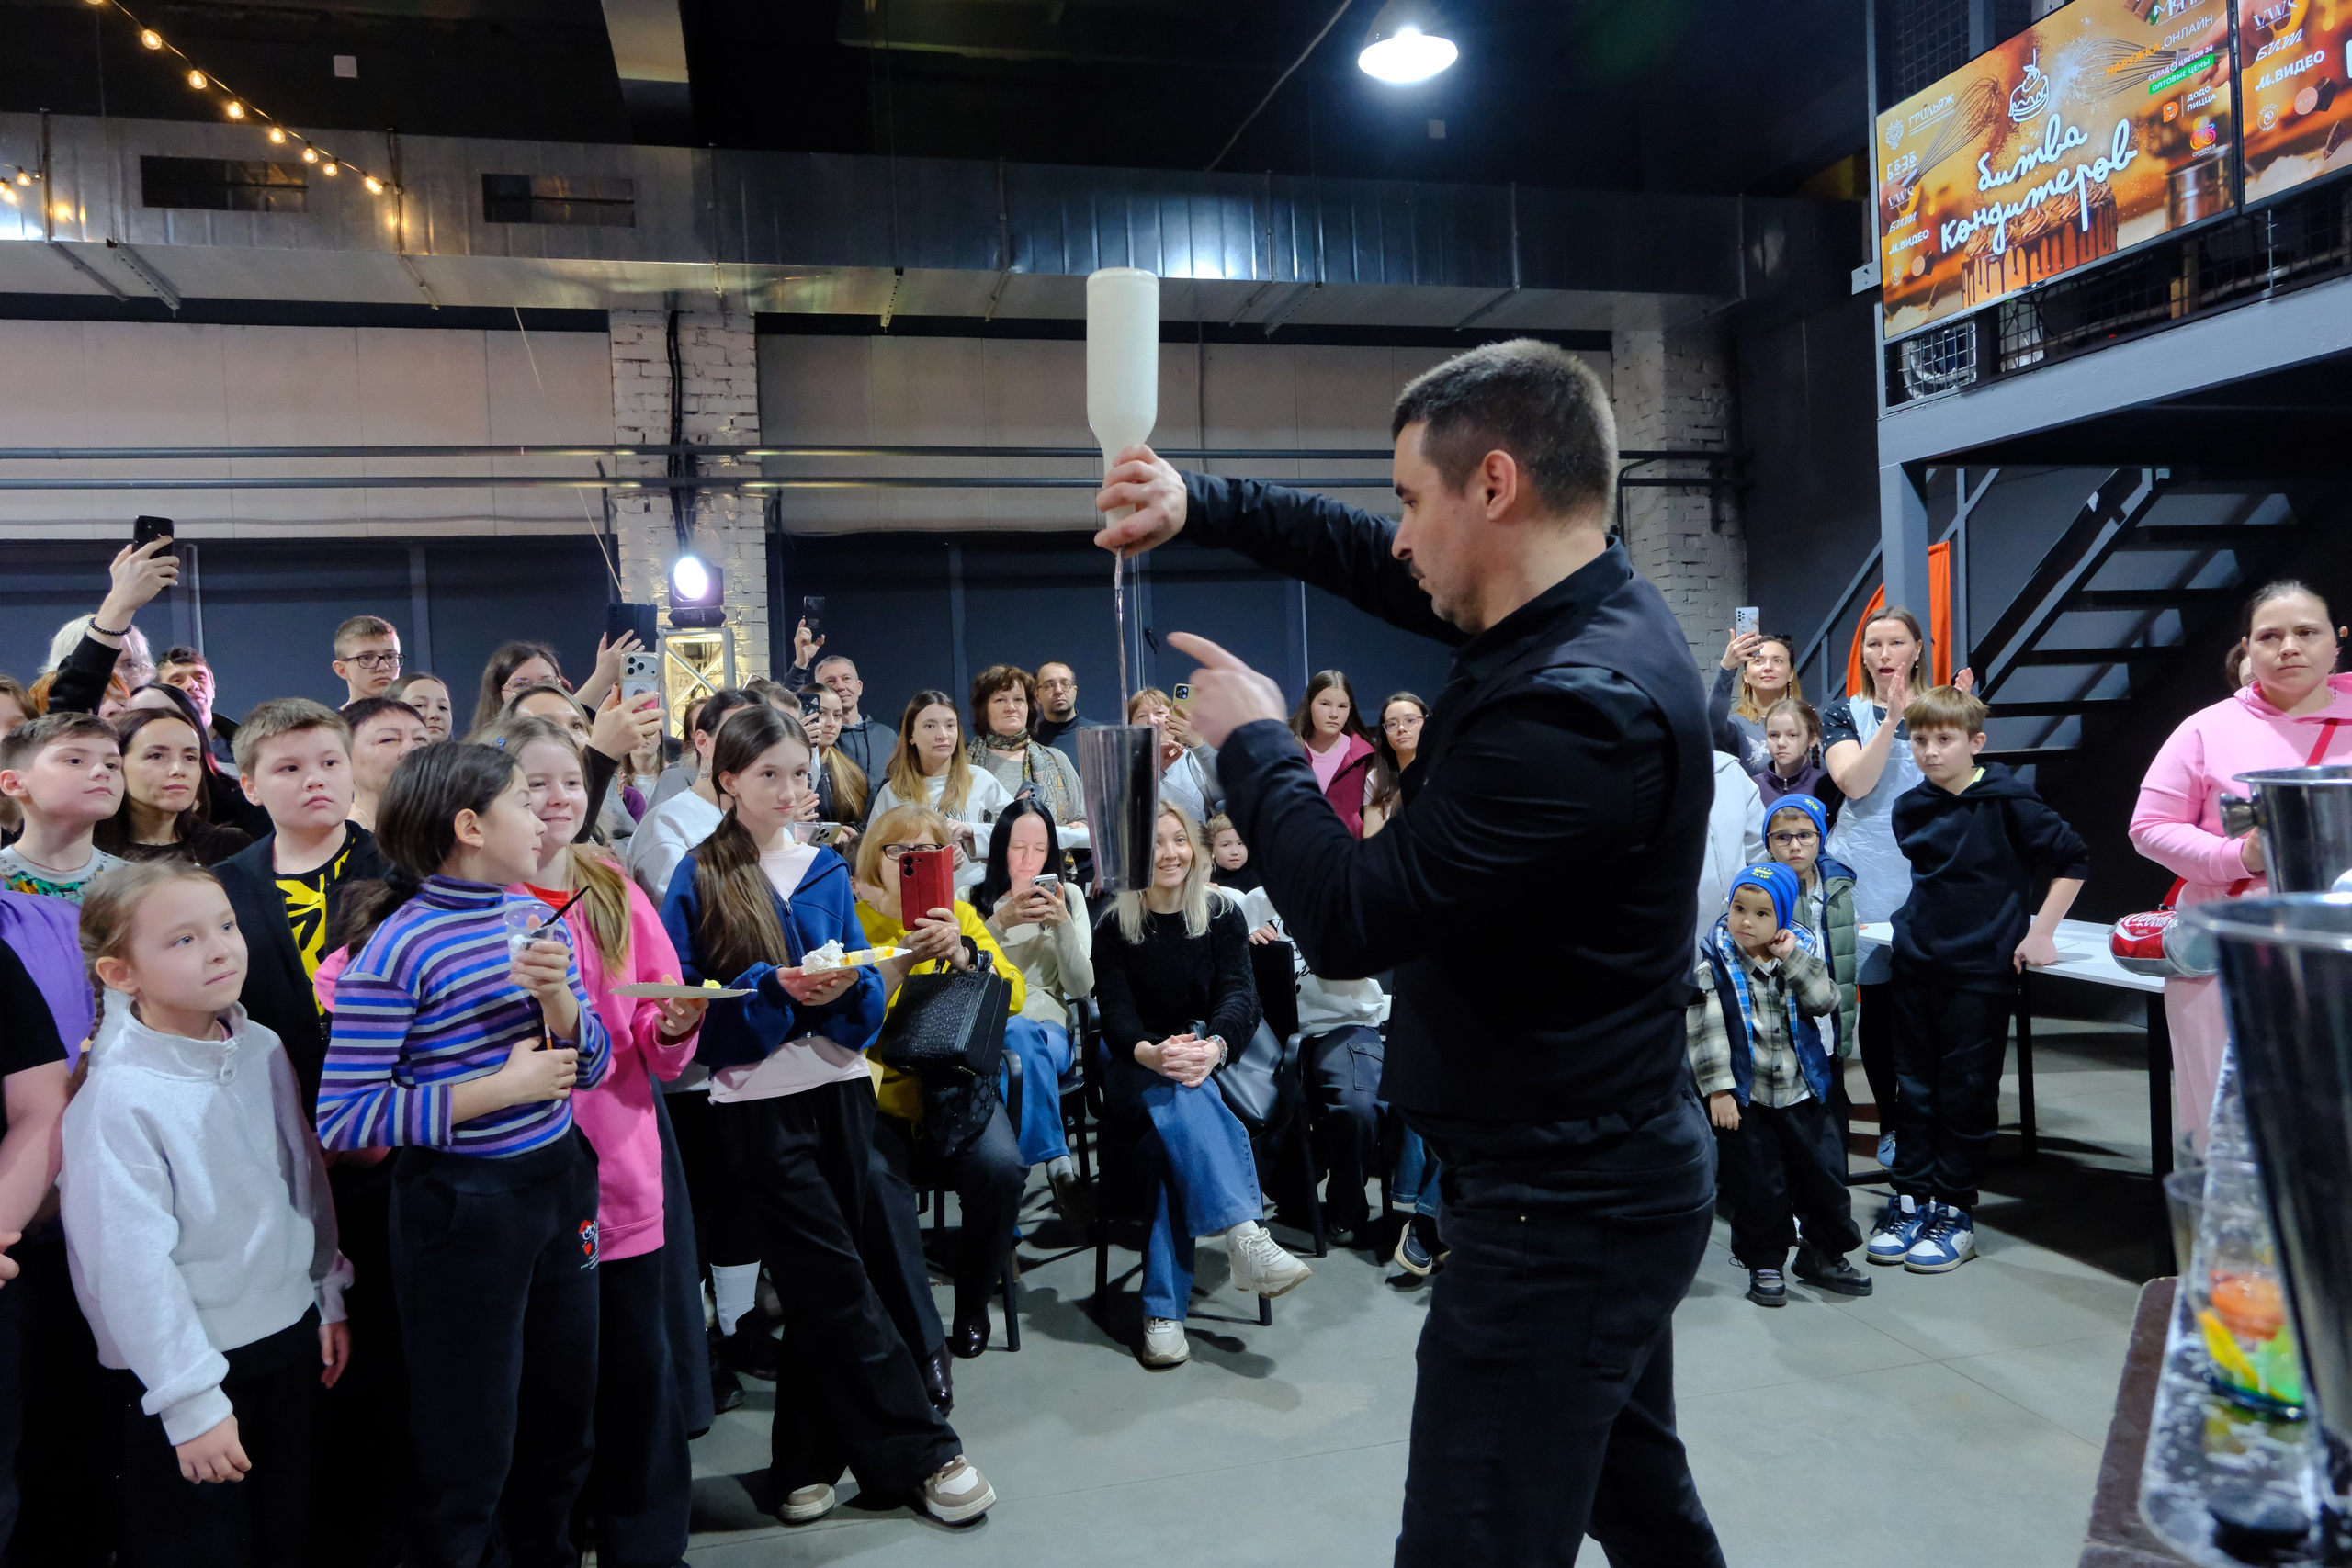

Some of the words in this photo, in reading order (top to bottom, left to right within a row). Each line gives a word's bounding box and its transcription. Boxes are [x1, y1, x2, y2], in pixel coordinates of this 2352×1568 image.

[2148, 66, 2170, 81] СКЛАД
[2178, 49, 2204, 67] ЦВЕТОВ
[2205, 44, 2213, 53] 24
[2152, 70, 2187, 92] ОПТОВЫЕ
[2188, 58, 2211, 74] ЦЕНЫ
[1908, 93, 1954, 128] ГРИЛЬЯЖ
[2187, 85, 2211, 103] ДОДО
[2187, 94, 2217, 111] ПИЦЦА
[1977, 113, 2088, 191] битва
